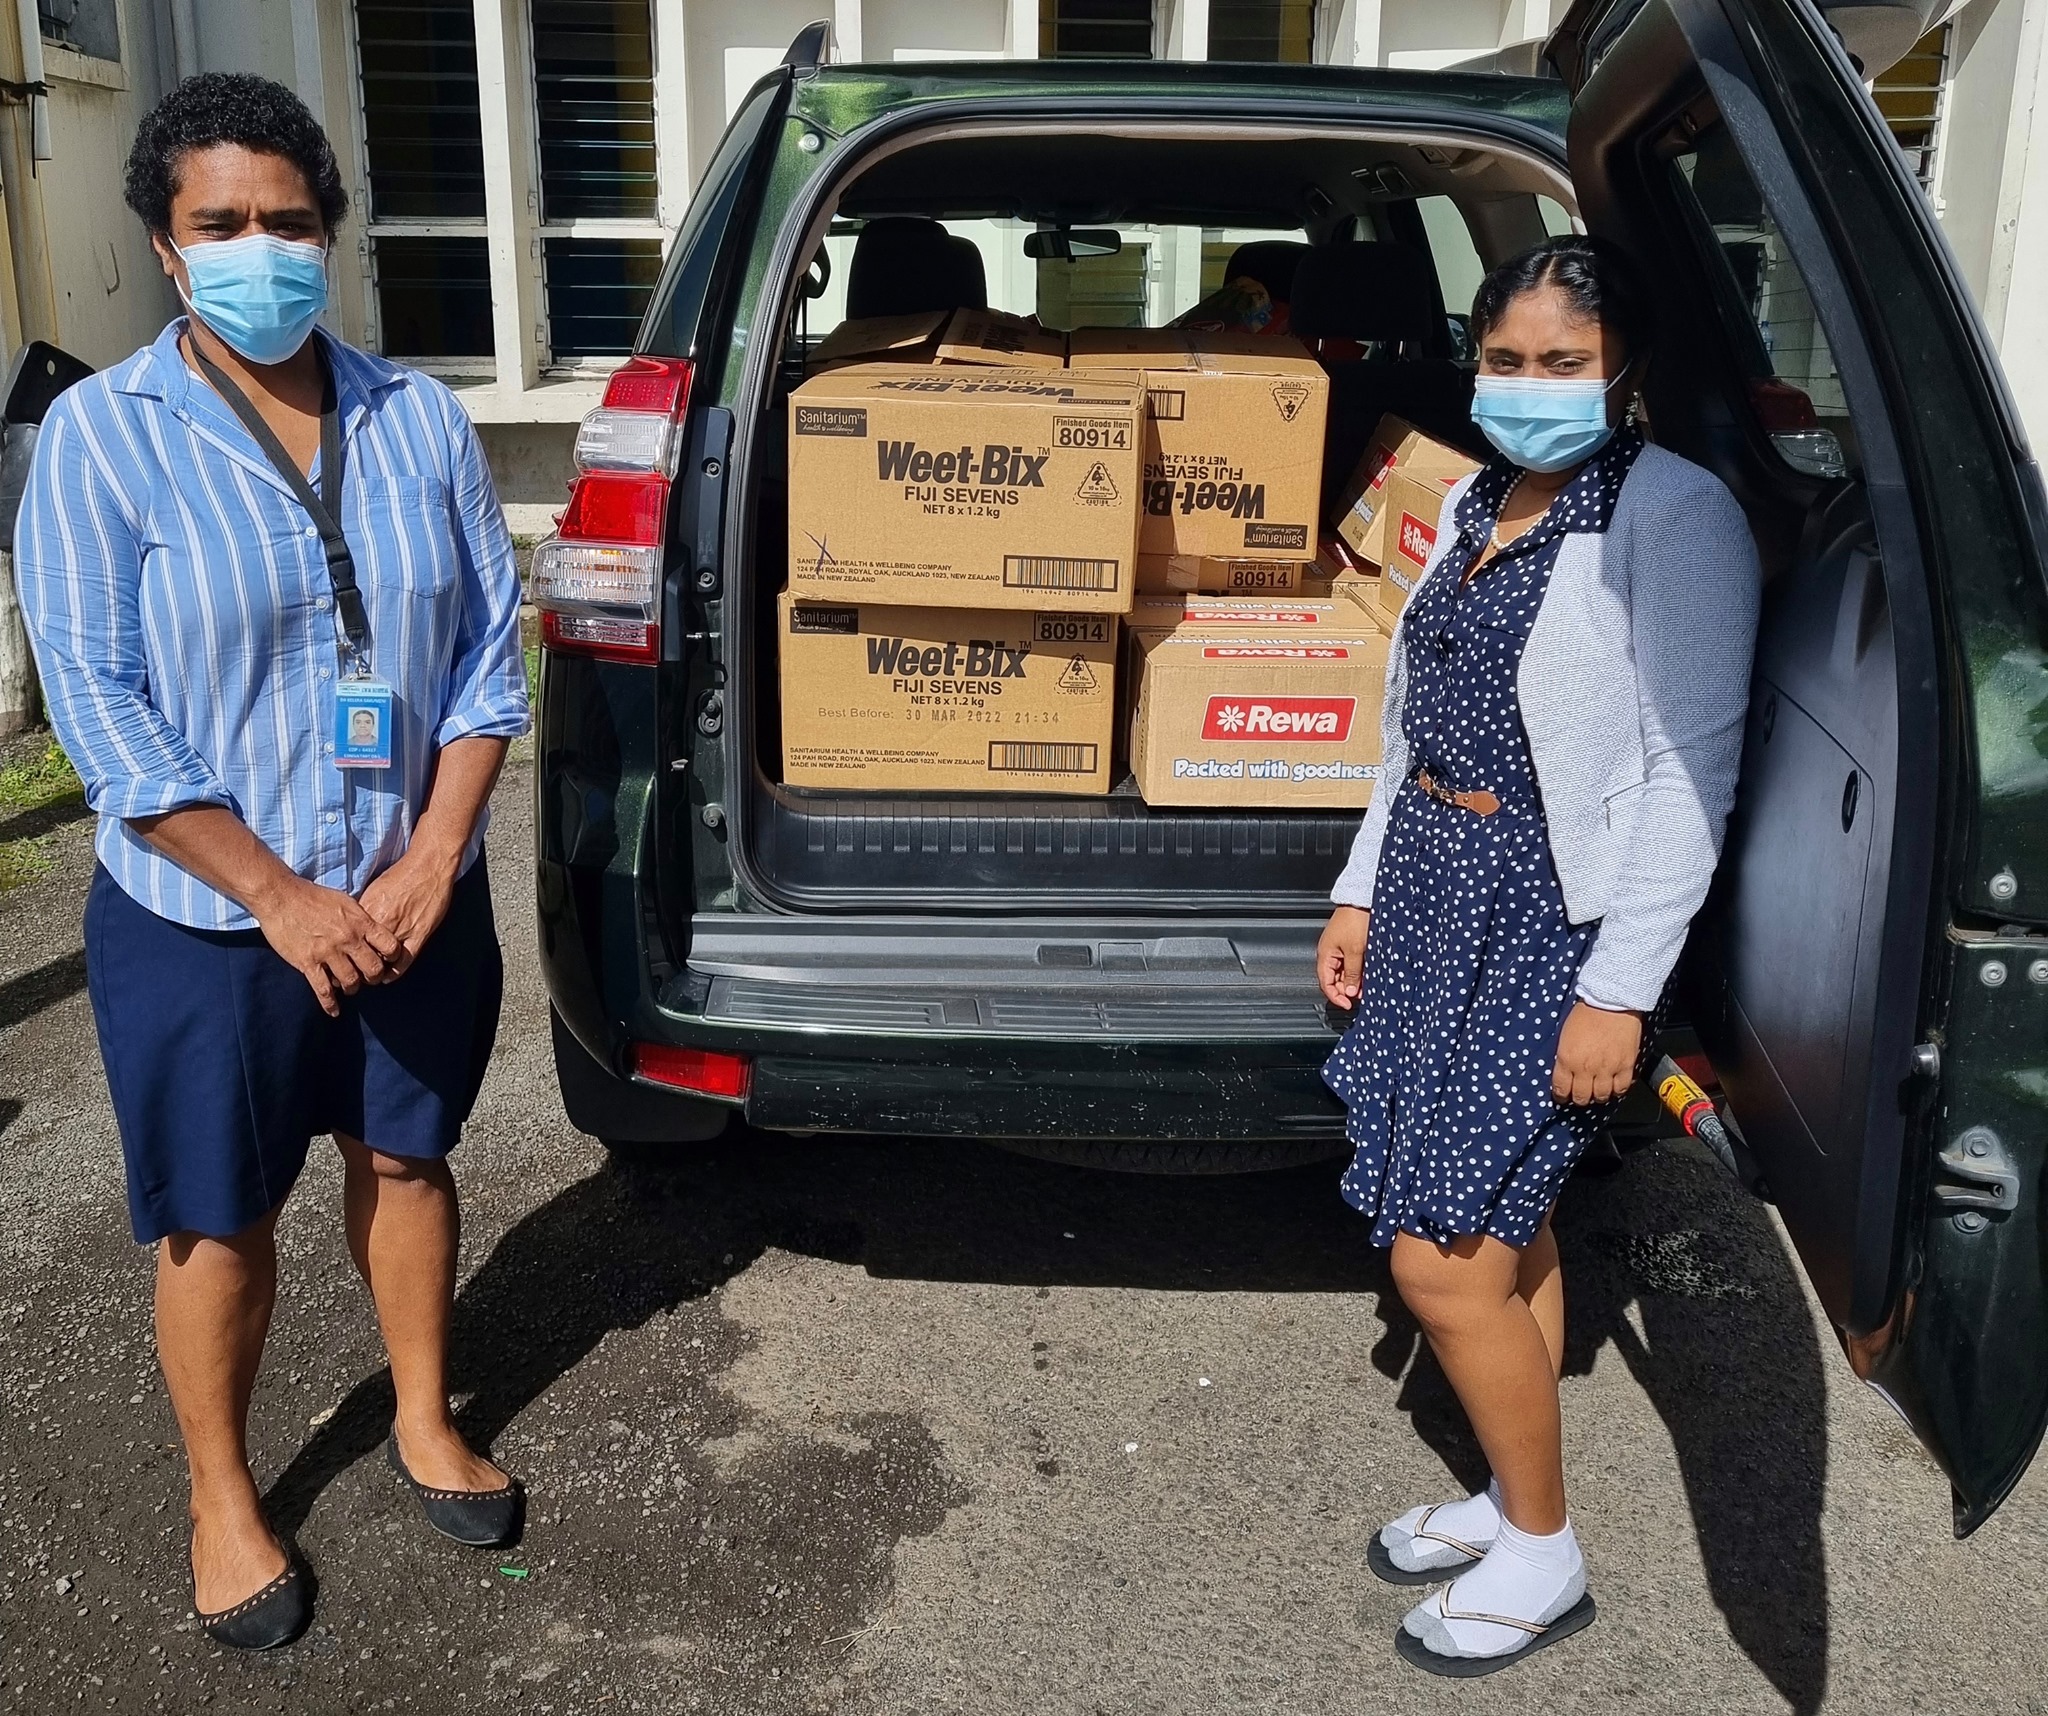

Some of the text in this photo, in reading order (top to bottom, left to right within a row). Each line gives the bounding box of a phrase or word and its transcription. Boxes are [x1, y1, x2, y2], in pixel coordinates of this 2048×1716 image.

[879, 381, 1073, 397] Weet-Bix
[800, 410, 858, 424] Sanitarium
[1056, 418, 1087, 427] Finished
[1089, 420, 1112, 428] Goods
[1059, 427, 1126, 448] 80914
[878, 440, 1050, 487] Weet-Bix
[1159, 453, 1172, 463] kg
[1174, 455, 1188, 463] 1.2
[1199, 456, 1205, 464] 8
[1207, 456, 1227, 464] NET
[1215, 465, 1243, 480] FIJI
[904, 486, 1019, 505] FIJI SEVENS
[923, 504, 945, 514] NET
[948, 506, 955, 515] 8
[967, 507, 983, 516] 1.2
[986, 506, 1000, 519] kg
[1253, 533, 1303, 547] Sanitarium
[825, 567, 847, 575] ROAD,
[875, 561, 916, 570] WELLBEING
[917, 563, 952, 571] COMPANY
[1233, 571, 1287, 587] 80914
[793, 610, 849, 624] Sanitarium
[1037, 614, 1067, 622] Finished
[1068, 614, 1090, 622] Goods
[1195, 612, 1277, 621] Rewa
[1040, 623, 1103, 640] 80914
[1299, 638, 1366, 646] Packed
[867, 638, 1031, 678] Weet-Bix
[1218, 649, 1307, 657] Rewa
[893, 679, 1002, 695] FIJI SEVENS
[911, 695, 932, 705] NET
[934, 696, 941, 705] 8
[953, 697, 968, 706] 1.2
[971, 697, 984, 708] kg
[818, 707, 1060, 724] Best Before: 30 MAR 2022 21:34
[1246, 705, 1339, 733] Rewa
[1173, 759, 1244, 778] Packed
[1248, 760, 1289, 779] with
